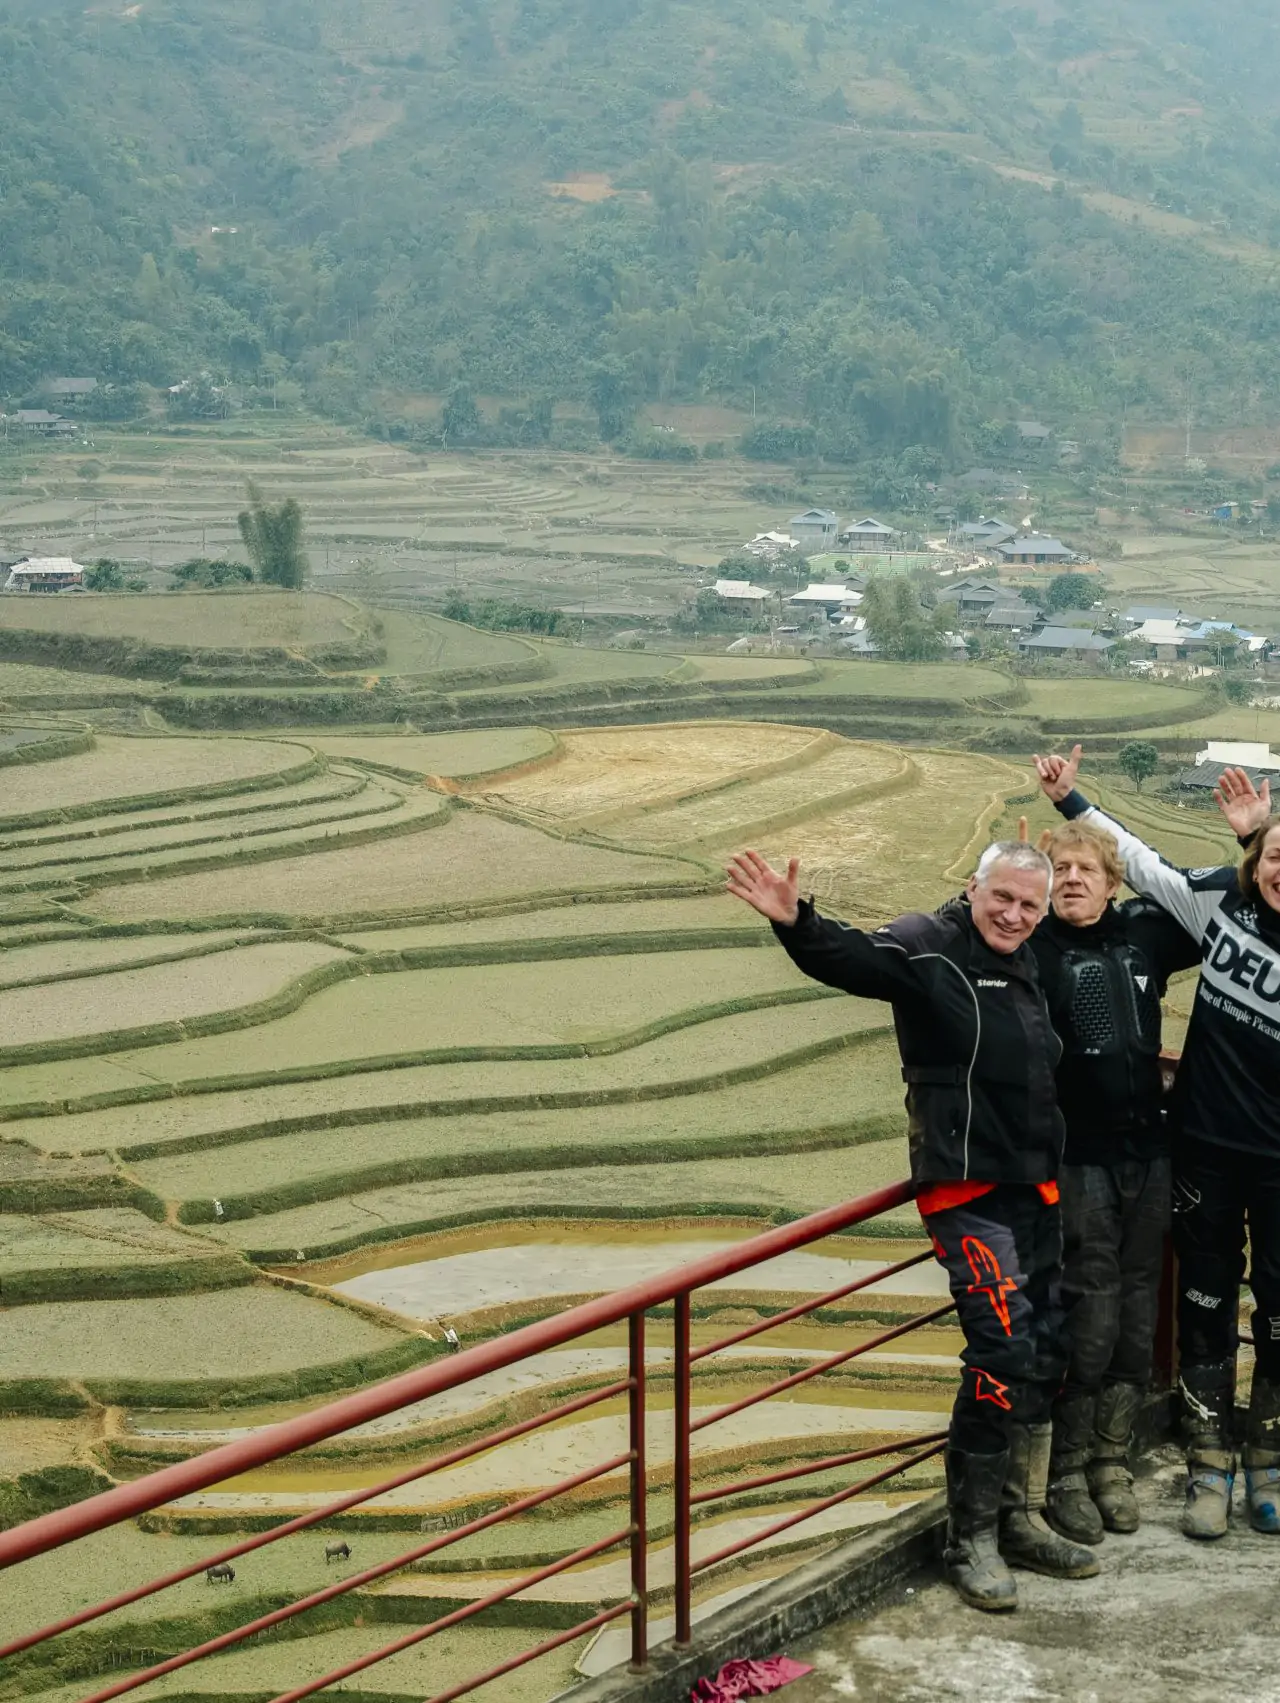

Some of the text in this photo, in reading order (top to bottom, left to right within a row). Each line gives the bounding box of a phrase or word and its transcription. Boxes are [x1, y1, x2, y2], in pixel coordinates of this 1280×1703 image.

[1213, 996, 1223, 1009] of
[1222, 998, 1252, 1024] Simple
[1185, 1287, 1222, 1309] SHOT
